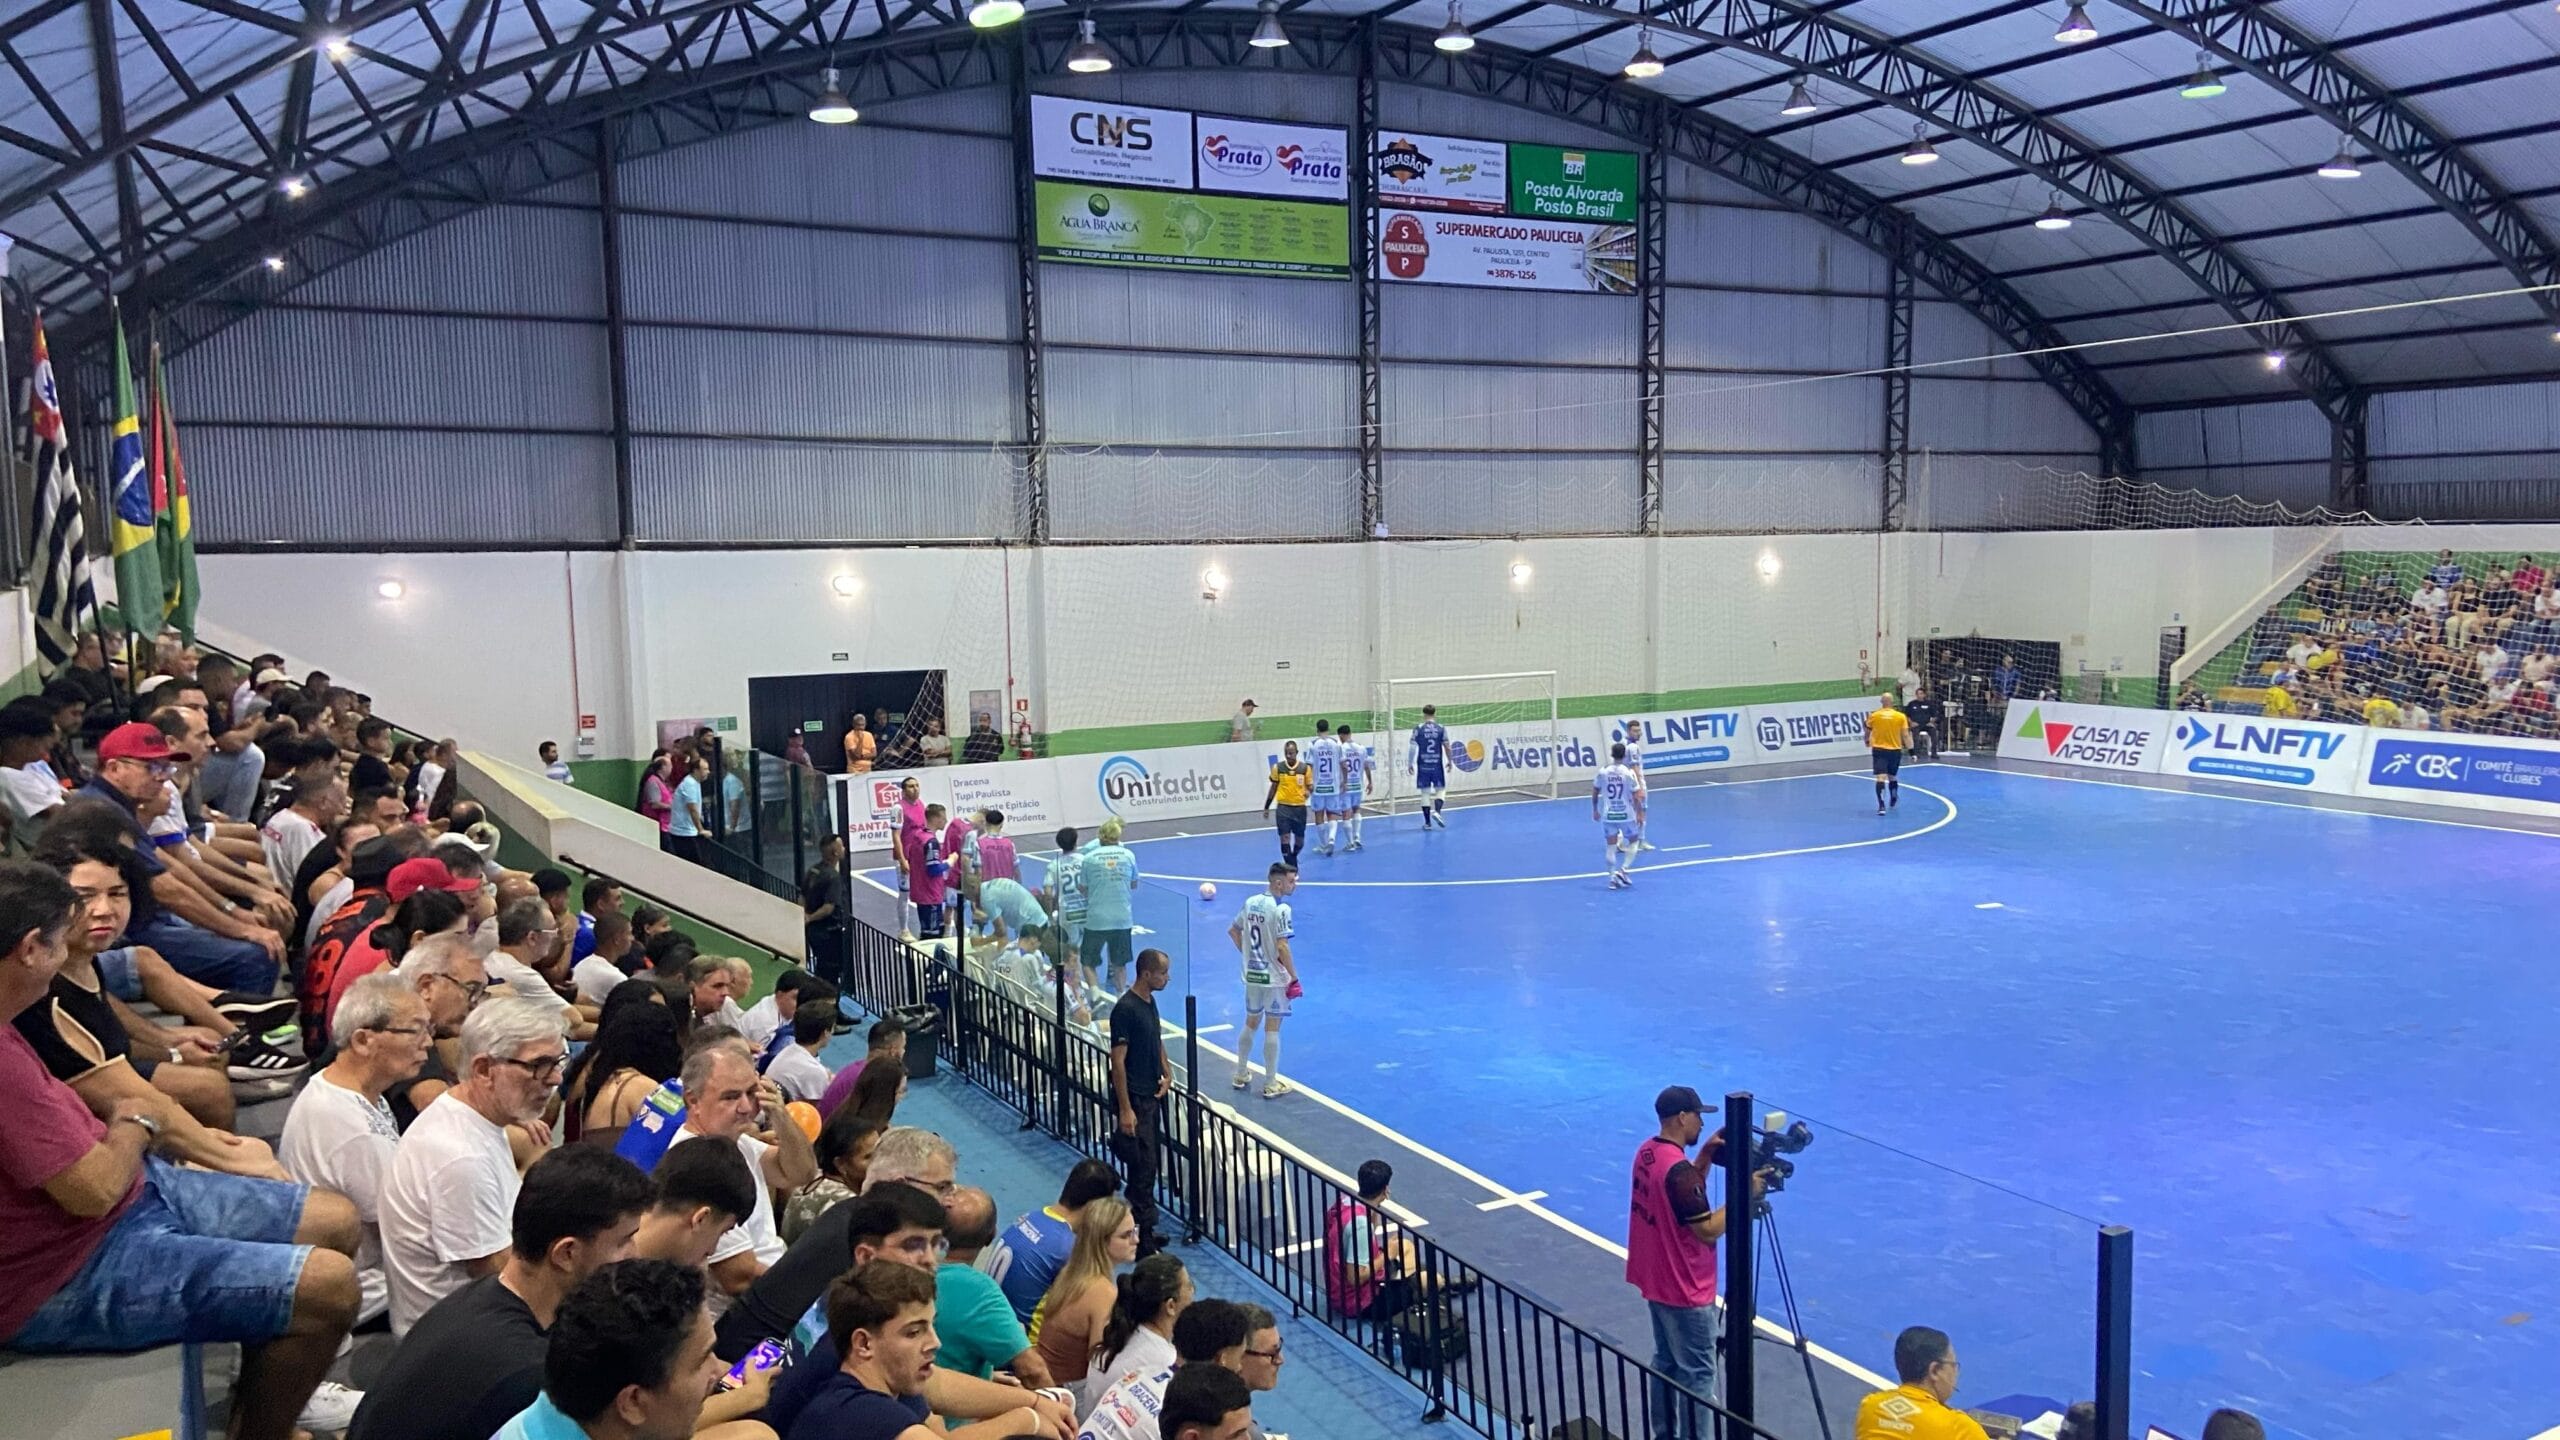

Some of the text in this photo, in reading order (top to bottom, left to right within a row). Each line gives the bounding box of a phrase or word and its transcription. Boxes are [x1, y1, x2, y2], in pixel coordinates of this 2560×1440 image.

[1070, 112, 1152, 150] CNS
[1218, 146, 1263, 166] Prata
[1384, 153, 1422, 172] BRASÃO
[1290, 157, 1341, 178] Prata
[1565, 163, 1583, 176] BR
[1524, 181, 1624, 202] Posto Alvorada
[1534, 198, 1615, 217] Posto Brasil
[1093, 218, 1139, 234] BRANCA
[1401, 226, 1409, 239] S
[1436, 222, 1528, 241] SUPERMERCADO
[1401, 257, 1410, 270] P
[1644, 713, 1739, 744] LNFTV
[2072, 725, 2150, 747] CASA DE
[1426, 739, 1435, 753] 2
[2214, 723, 2347, 760] LNFTV
[1492, 736, 1597, 770] Avenida
[2056, 744, 2141, 766] APOSTAS
[1320, 758, 1333, 773] 21
[2416, 754, 2463, 780] CBC
[2475, 760, 2513, 773] COMITÊ
[953, 778, 990, 787] Dracena
[1105, 769, 1226, 800] Unifadra
[2502, 773, 2541, 786] CLUBES
[884, 792, 900, 801] SH
[955, 789, 1011, 801] Tupi Paulista
[1130, 796, 1182, 806] Construindo
[1201, 792, 1228, 801] futuro
[1607, 783, 1624, 800] 97
[1006, 800, 1040, 811] Epitácio
[1007, 813, 1046, 822] Prudente
[850, 821, 889, 832] SANTA
[860, 831, 888, 840] HOME
[1248, 913, 1265, 923] LEVO
[1250, 924, 1262, 950] 9
[1128, 1384, 1161, 1419] DRACENA
